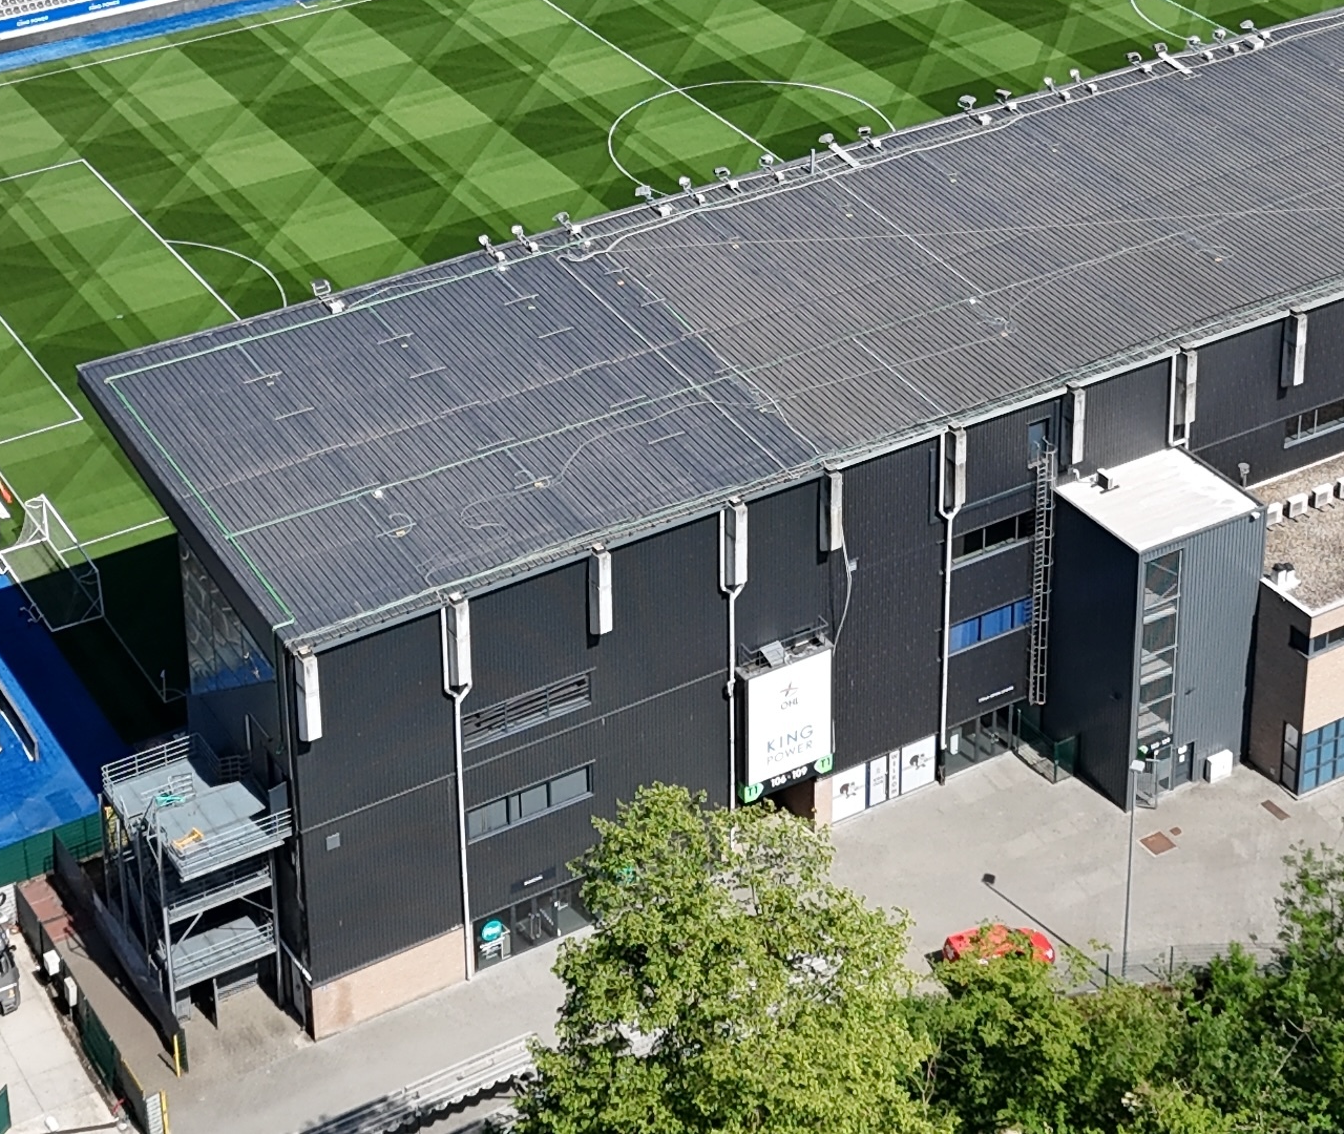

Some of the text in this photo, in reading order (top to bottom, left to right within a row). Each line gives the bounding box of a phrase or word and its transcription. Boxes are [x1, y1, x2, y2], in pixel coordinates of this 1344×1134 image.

[780, 697, 798, 710] OHL
[767, 724, 814, 754] KING
[766, 740, 813, 766] POWER
